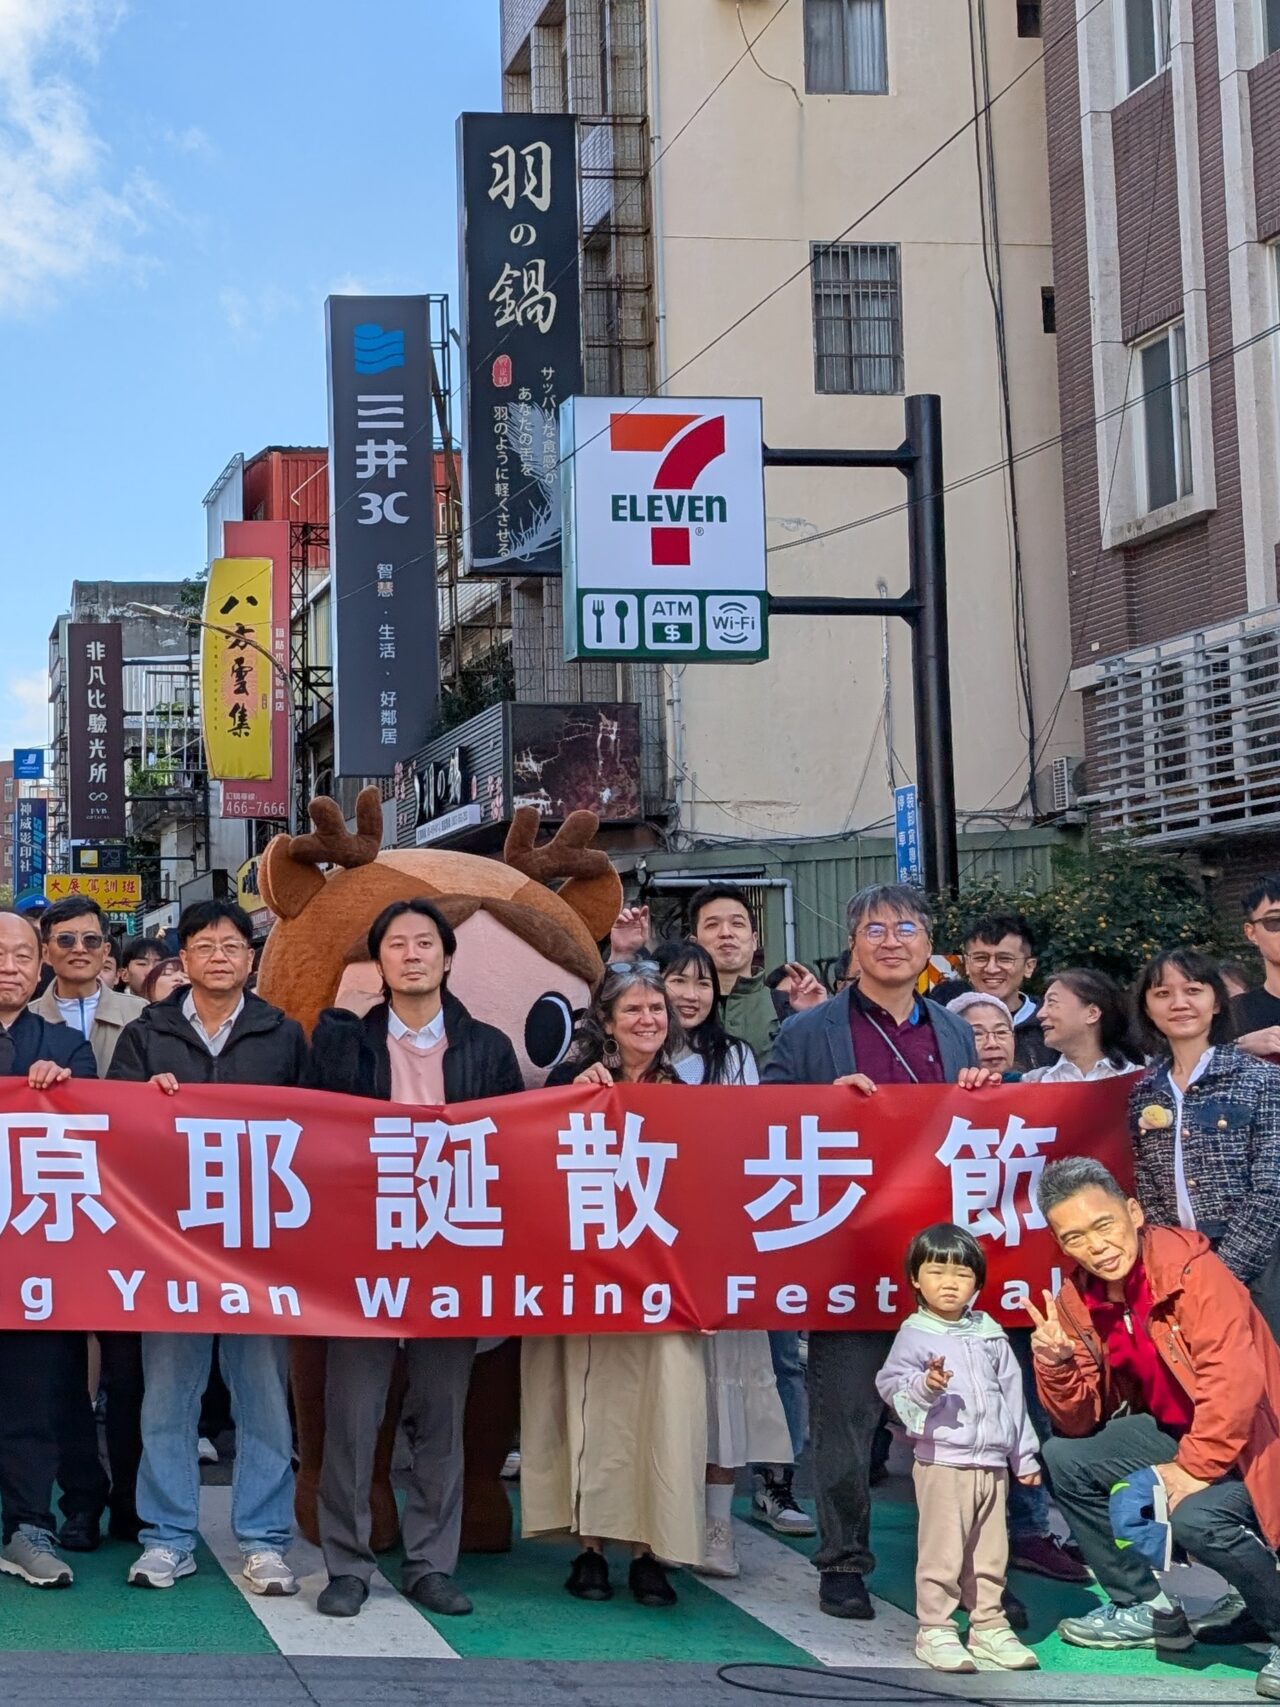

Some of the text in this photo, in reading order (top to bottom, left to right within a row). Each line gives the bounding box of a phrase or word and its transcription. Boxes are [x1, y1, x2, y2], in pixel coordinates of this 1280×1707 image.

[488, 141, 557, 334] 羽の鍋
[518, 386, 533, 477] あなたの舌を
[494, 406, 510, 558] 羽のように軽くさせる
[652, 601, 693, 616] ATM
[712, 616, 755, 631] Wi-Fi
[220, 595, 258, 738] 八方雲集
[86, 641, 108, 784] 非凡比驗光所
[20, 803, 32, 874] 神威影印社
[226, 801, 285, 816] 466-7666
[108, 1269, 301, 1316] Yuan
[355, 1274, 671, 1324] Walking
[726, 1266, 1061, 1316] Festal
